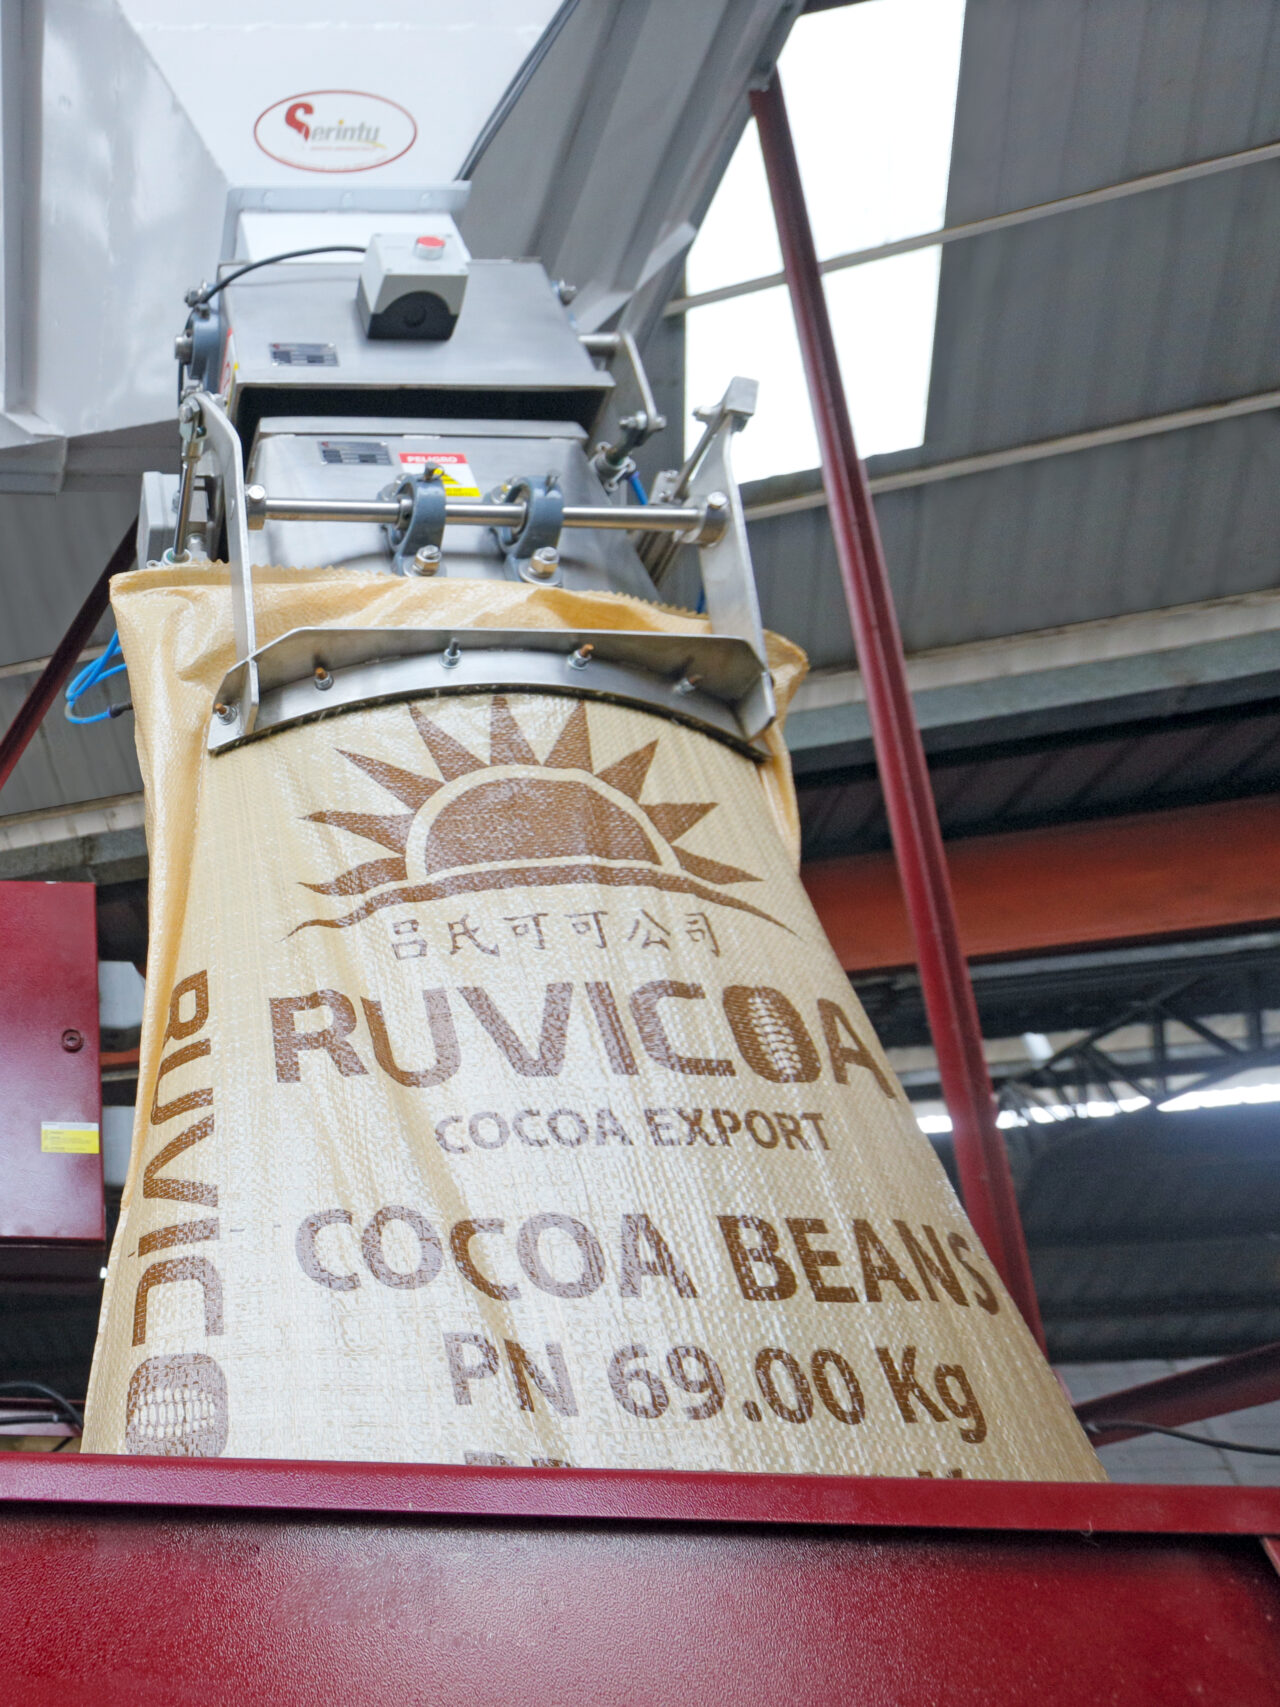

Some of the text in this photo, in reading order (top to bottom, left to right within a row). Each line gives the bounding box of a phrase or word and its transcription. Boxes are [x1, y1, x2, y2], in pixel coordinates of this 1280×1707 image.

[407, 455, 458, 464] PELIGRO
[268, 979, 896, 1099] RUVICOA
[437, 1106, 832, 1156] COCOA EXPORT
[294, 1203, 1001, 1317] COCOA BEANS
[444, 1331, 988, 1446] PN 69.00 Kg
